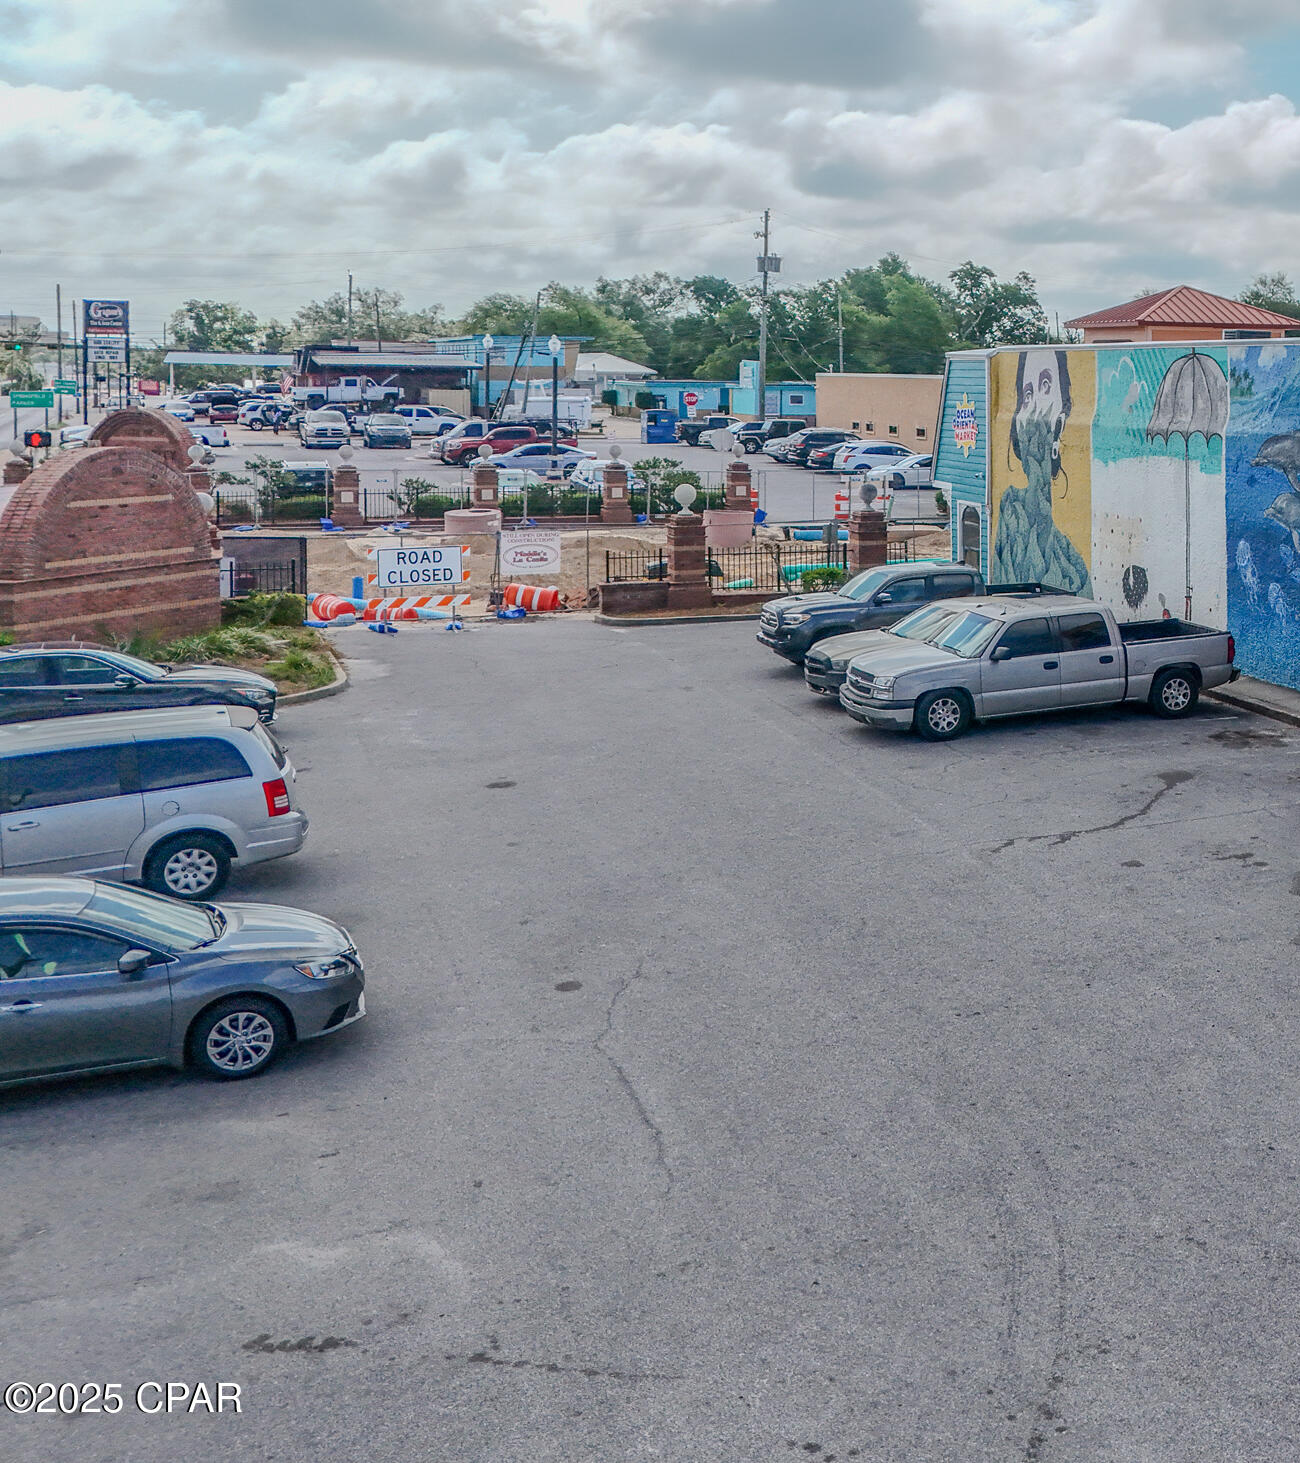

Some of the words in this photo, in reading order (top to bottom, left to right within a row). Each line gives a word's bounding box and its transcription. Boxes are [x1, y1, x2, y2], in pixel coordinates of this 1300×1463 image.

[956, 409, 975, 419] OCEAN
[952, 418, 978, 431] ORIENTAL
[955, 431, 976, 441] MARKET
[396, 550, 443, 565] ROAD
[387, 568, 453, 584] CLOSED
